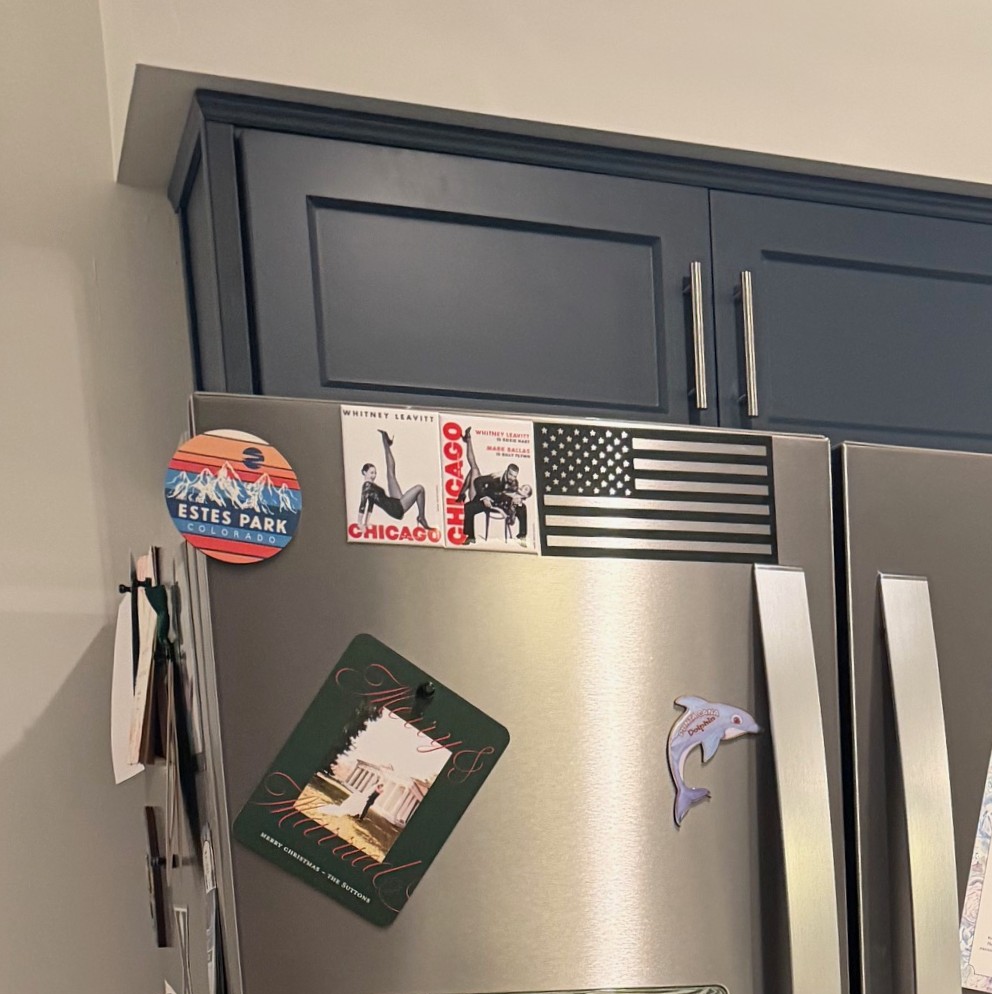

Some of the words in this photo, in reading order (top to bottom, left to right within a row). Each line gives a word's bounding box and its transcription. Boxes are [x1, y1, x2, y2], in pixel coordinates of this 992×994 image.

[343, 409, 389, 420] WHITNEY
[395, 413, 434, 422] LEAVITT
[443, 422, 468, 546] CHICAGO
[178, 503, 232, 525] ESTES
[239, 513, 288, 534] PARK
[187, 523, 276, 544] COLORADO
[348, 523, 442, 543] CHICAGO
[688, 716, 716, 736] Dolphin
[260, 832, 283, 848] MERRY
[284, 846, 320, 872] CHRISTMAS
[327, 874, 340, 885] THE
